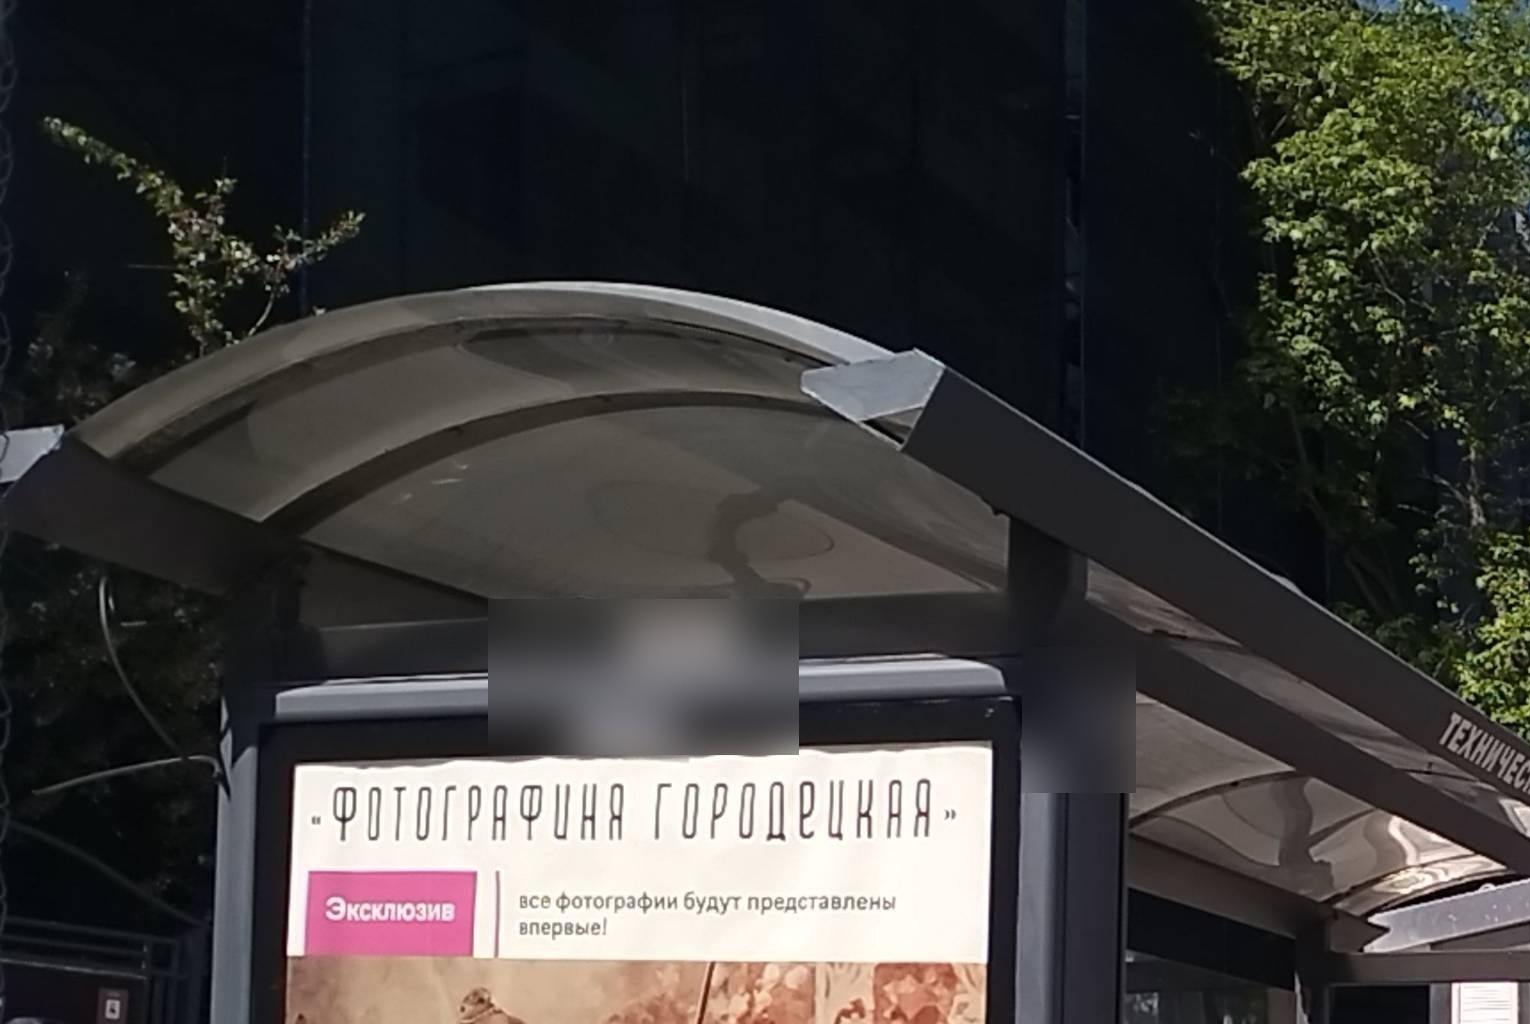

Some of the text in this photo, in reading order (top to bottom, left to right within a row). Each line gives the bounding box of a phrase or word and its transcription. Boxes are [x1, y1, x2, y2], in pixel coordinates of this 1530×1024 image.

[325, 897, 455, 921] Эксклюзив
[519, 891, 897, 915] все фотографии будут представлены
[519, 918, 608, 940] впервые!
